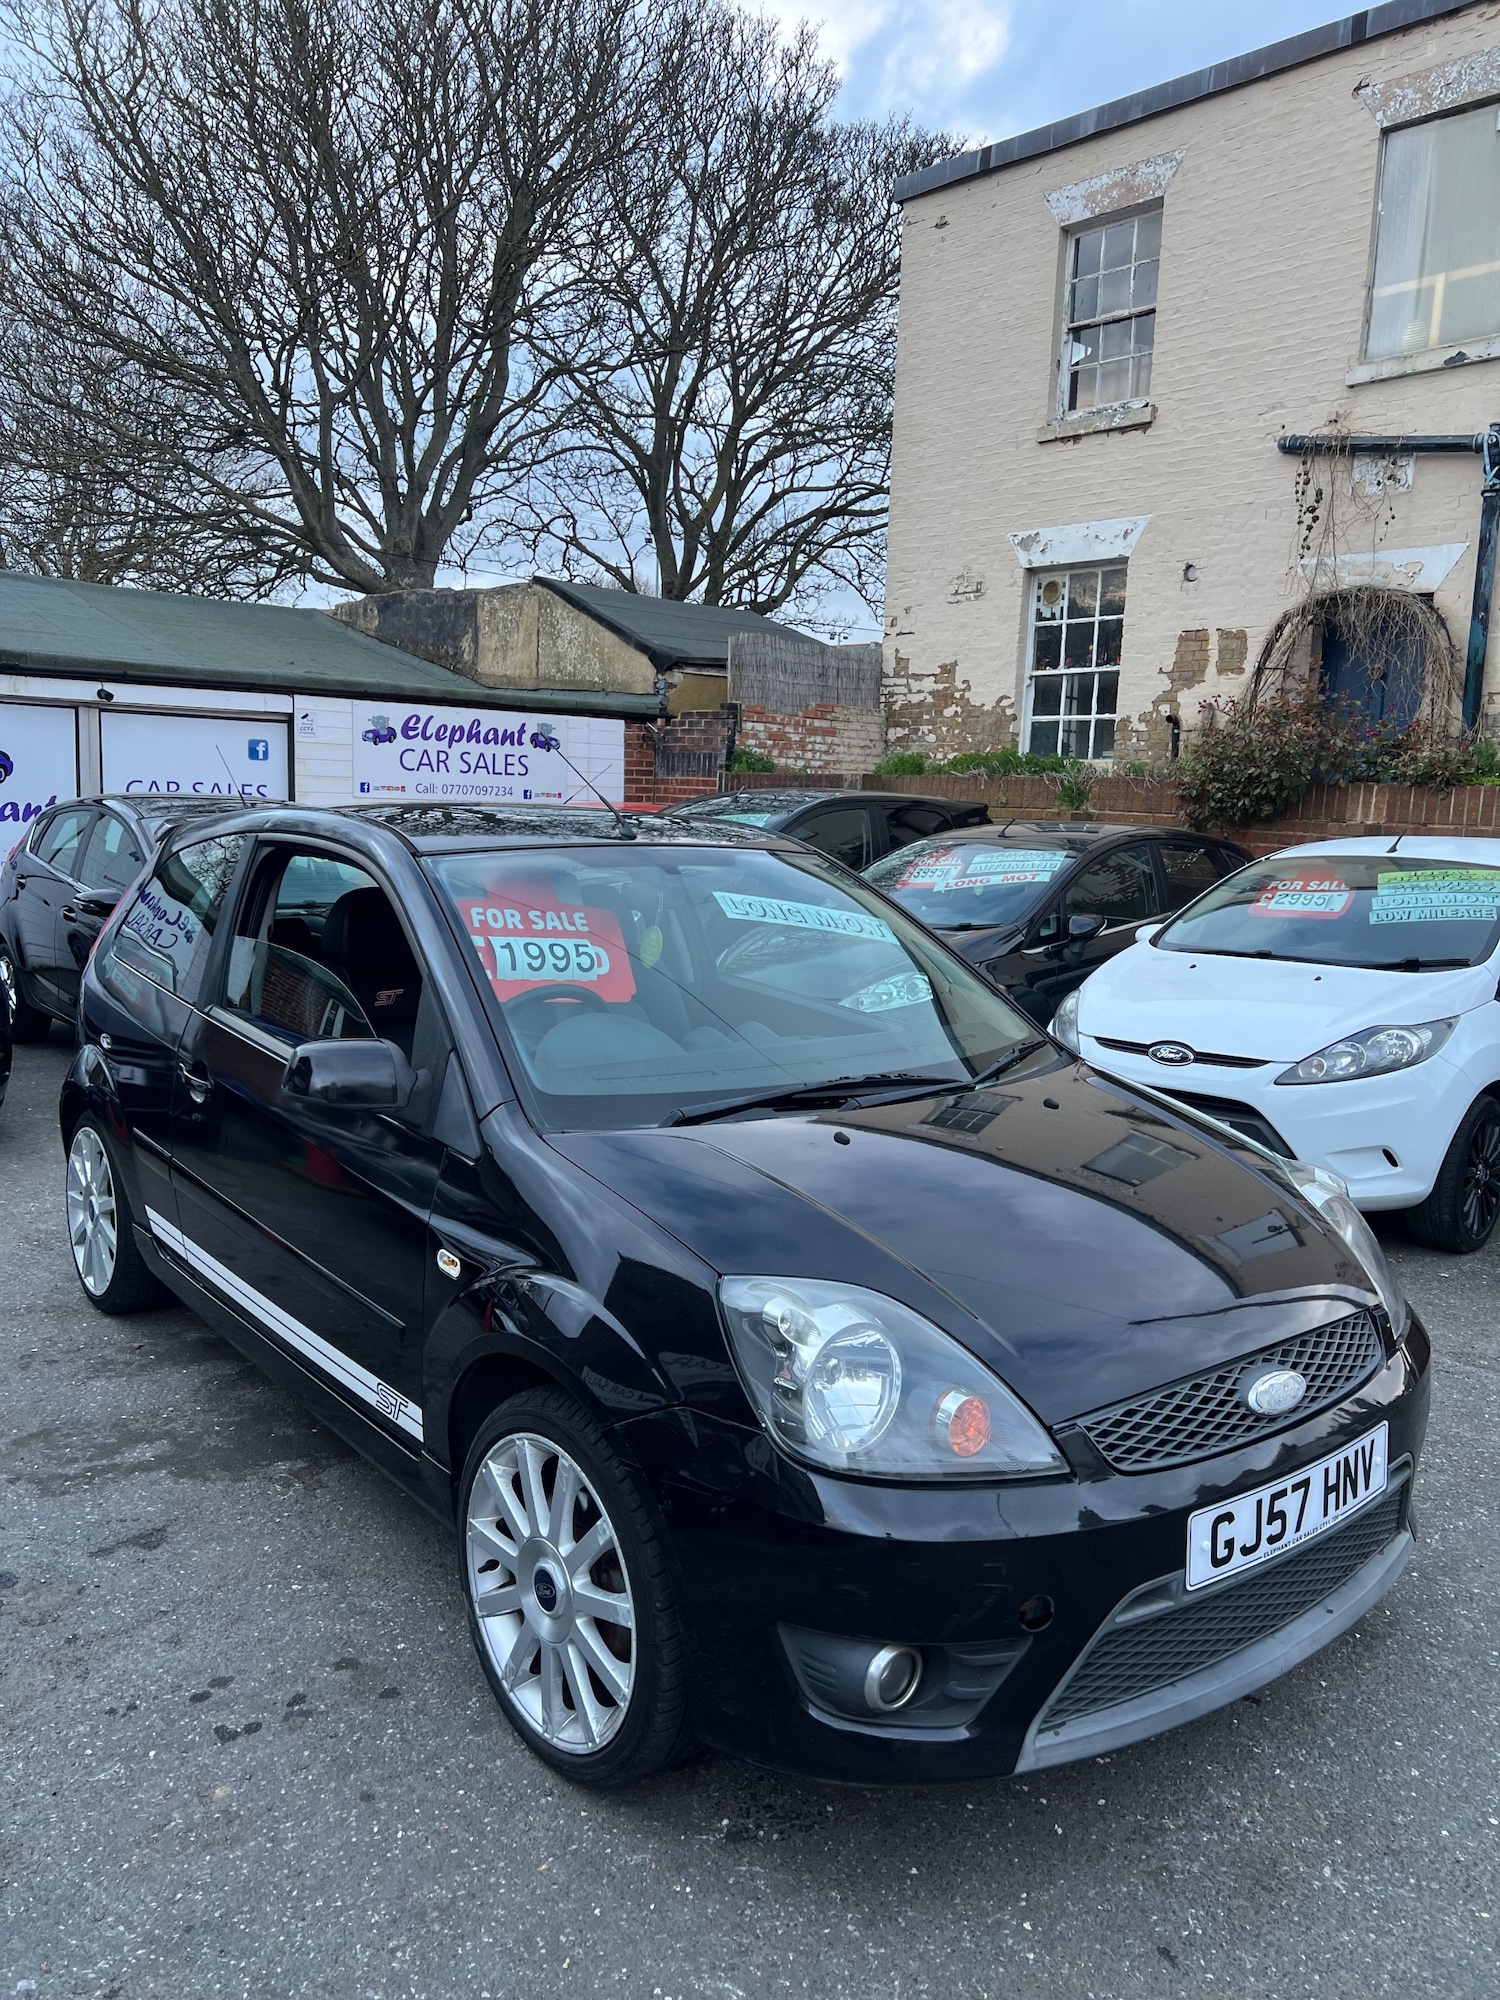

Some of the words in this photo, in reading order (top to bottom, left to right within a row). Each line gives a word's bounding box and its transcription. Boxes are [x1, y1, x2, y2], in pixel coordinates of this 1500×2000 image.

[400, 713, 527, 749] Elephant
[399, 748, 450, 773] CAR
[459, 751, 529, 777] SALES
[415, 782, 439, 795] Call:
[441, 784, 514, 797] 07707097234
[944, 877, 991, 889] LONG
[1001, 873, 1040, 883] MOT
[1267, 880, 1304, 890] FOR
[720, 894, 809, 924] LONG
[1376, 896, 1433, 907] LONG
[470, 907, 525, 930] FOR
[528, 910, 590, 932] SALE
[1374, 910, 1411, 922] LOW
[1416, 908, 1494, 920] MILEAGE
[499, 942, 596, 973] 1995
[374, 988, 405, 1007] ST
[1156, 1047, 1184, 1061] Ford
[375, 1382, 409, 1421] ST
[1209, 1475, 1312, 1569] GJ57
[1322, 1438, 1375, 1519] HNV
[1263, 1540, 1292, 1559] ELEPHANT
[1292, 1535, 1303, 1545] CAR
[1303, 1526, 1319, 1539] SALES
